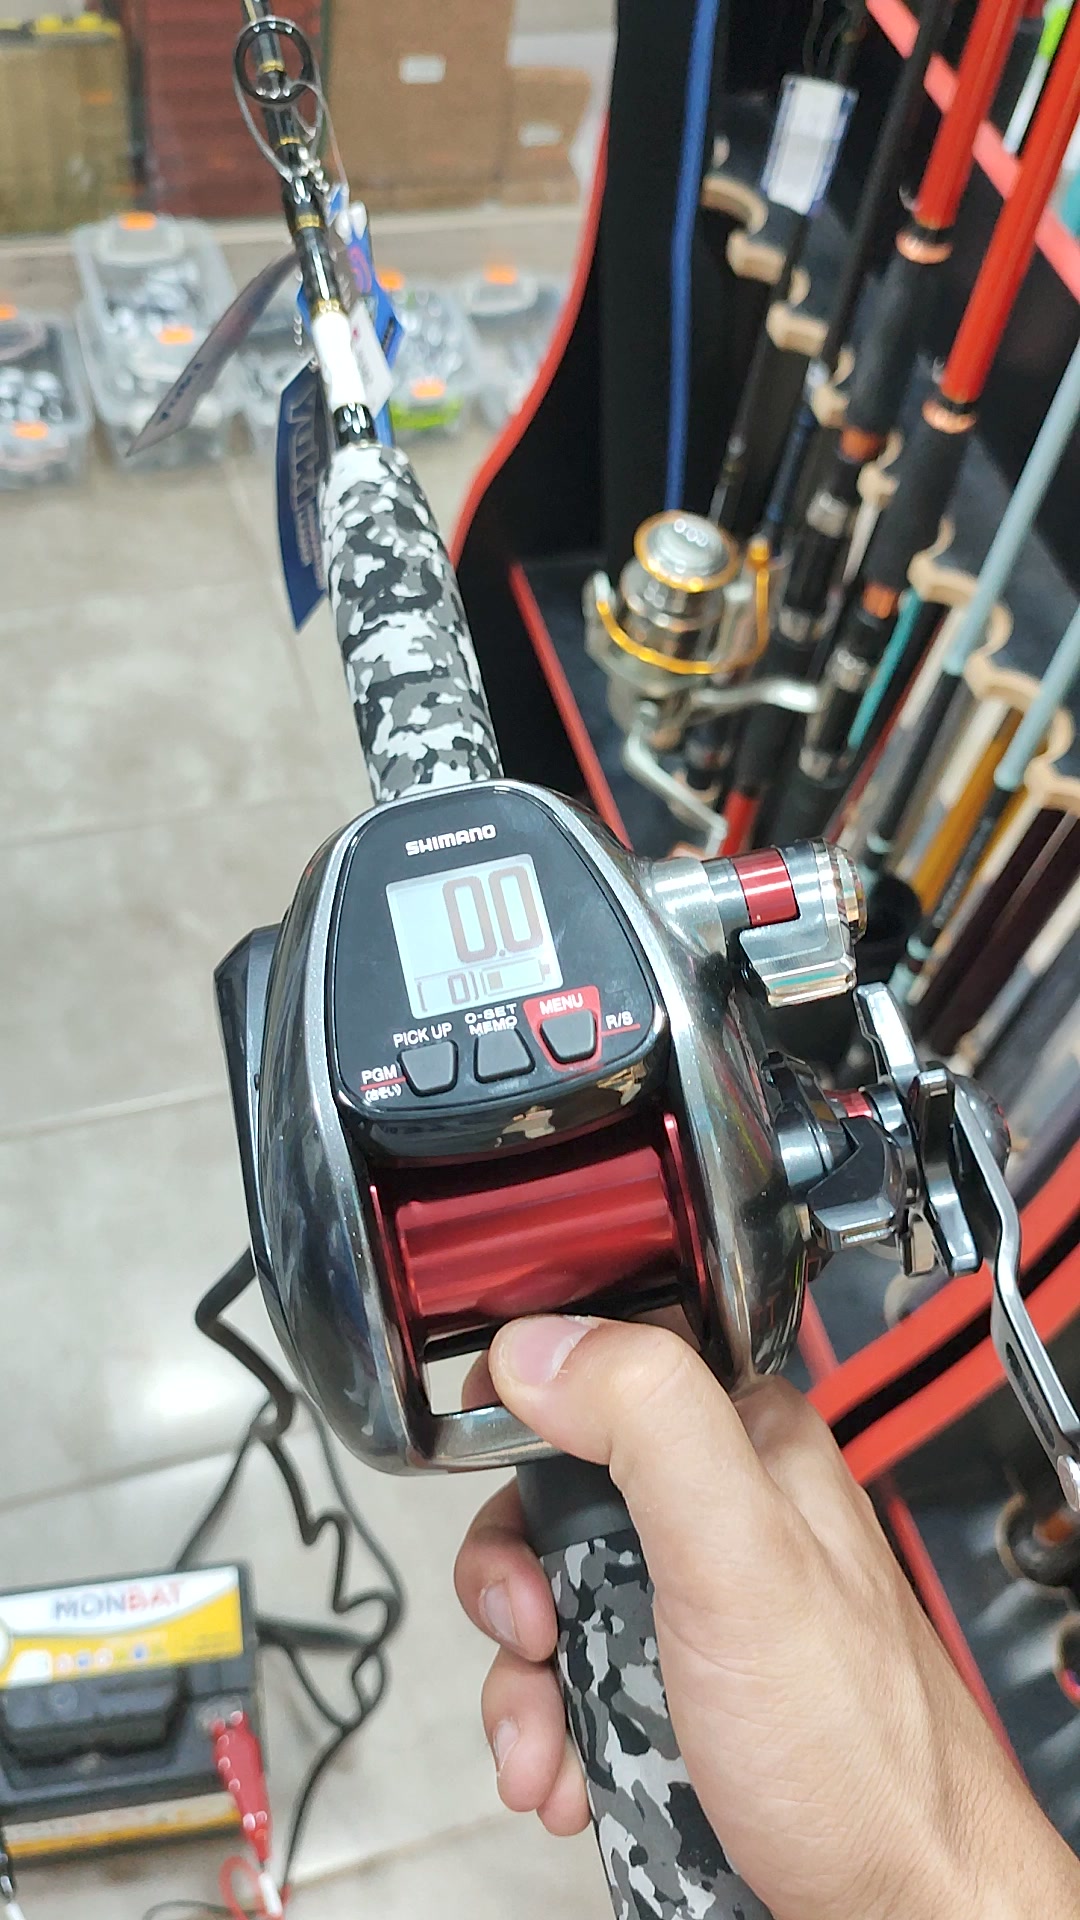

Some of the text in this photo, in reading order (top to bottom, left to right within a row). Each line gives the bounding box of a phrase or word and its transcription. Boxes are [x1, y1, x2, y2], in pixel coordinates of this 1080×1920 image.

[405, 824, 496, 856] SHIMANO
[539, 993, 584, 1015] MENU
[468, 1015, 518, 1036] MEMO
[605, 1011, 634, 1029] R/S
[393, 1022, 453, 1048] PICK UP
[361, 1063, 398, 1085] PGM
[55, 1582, 184, 1620] MONBAT
